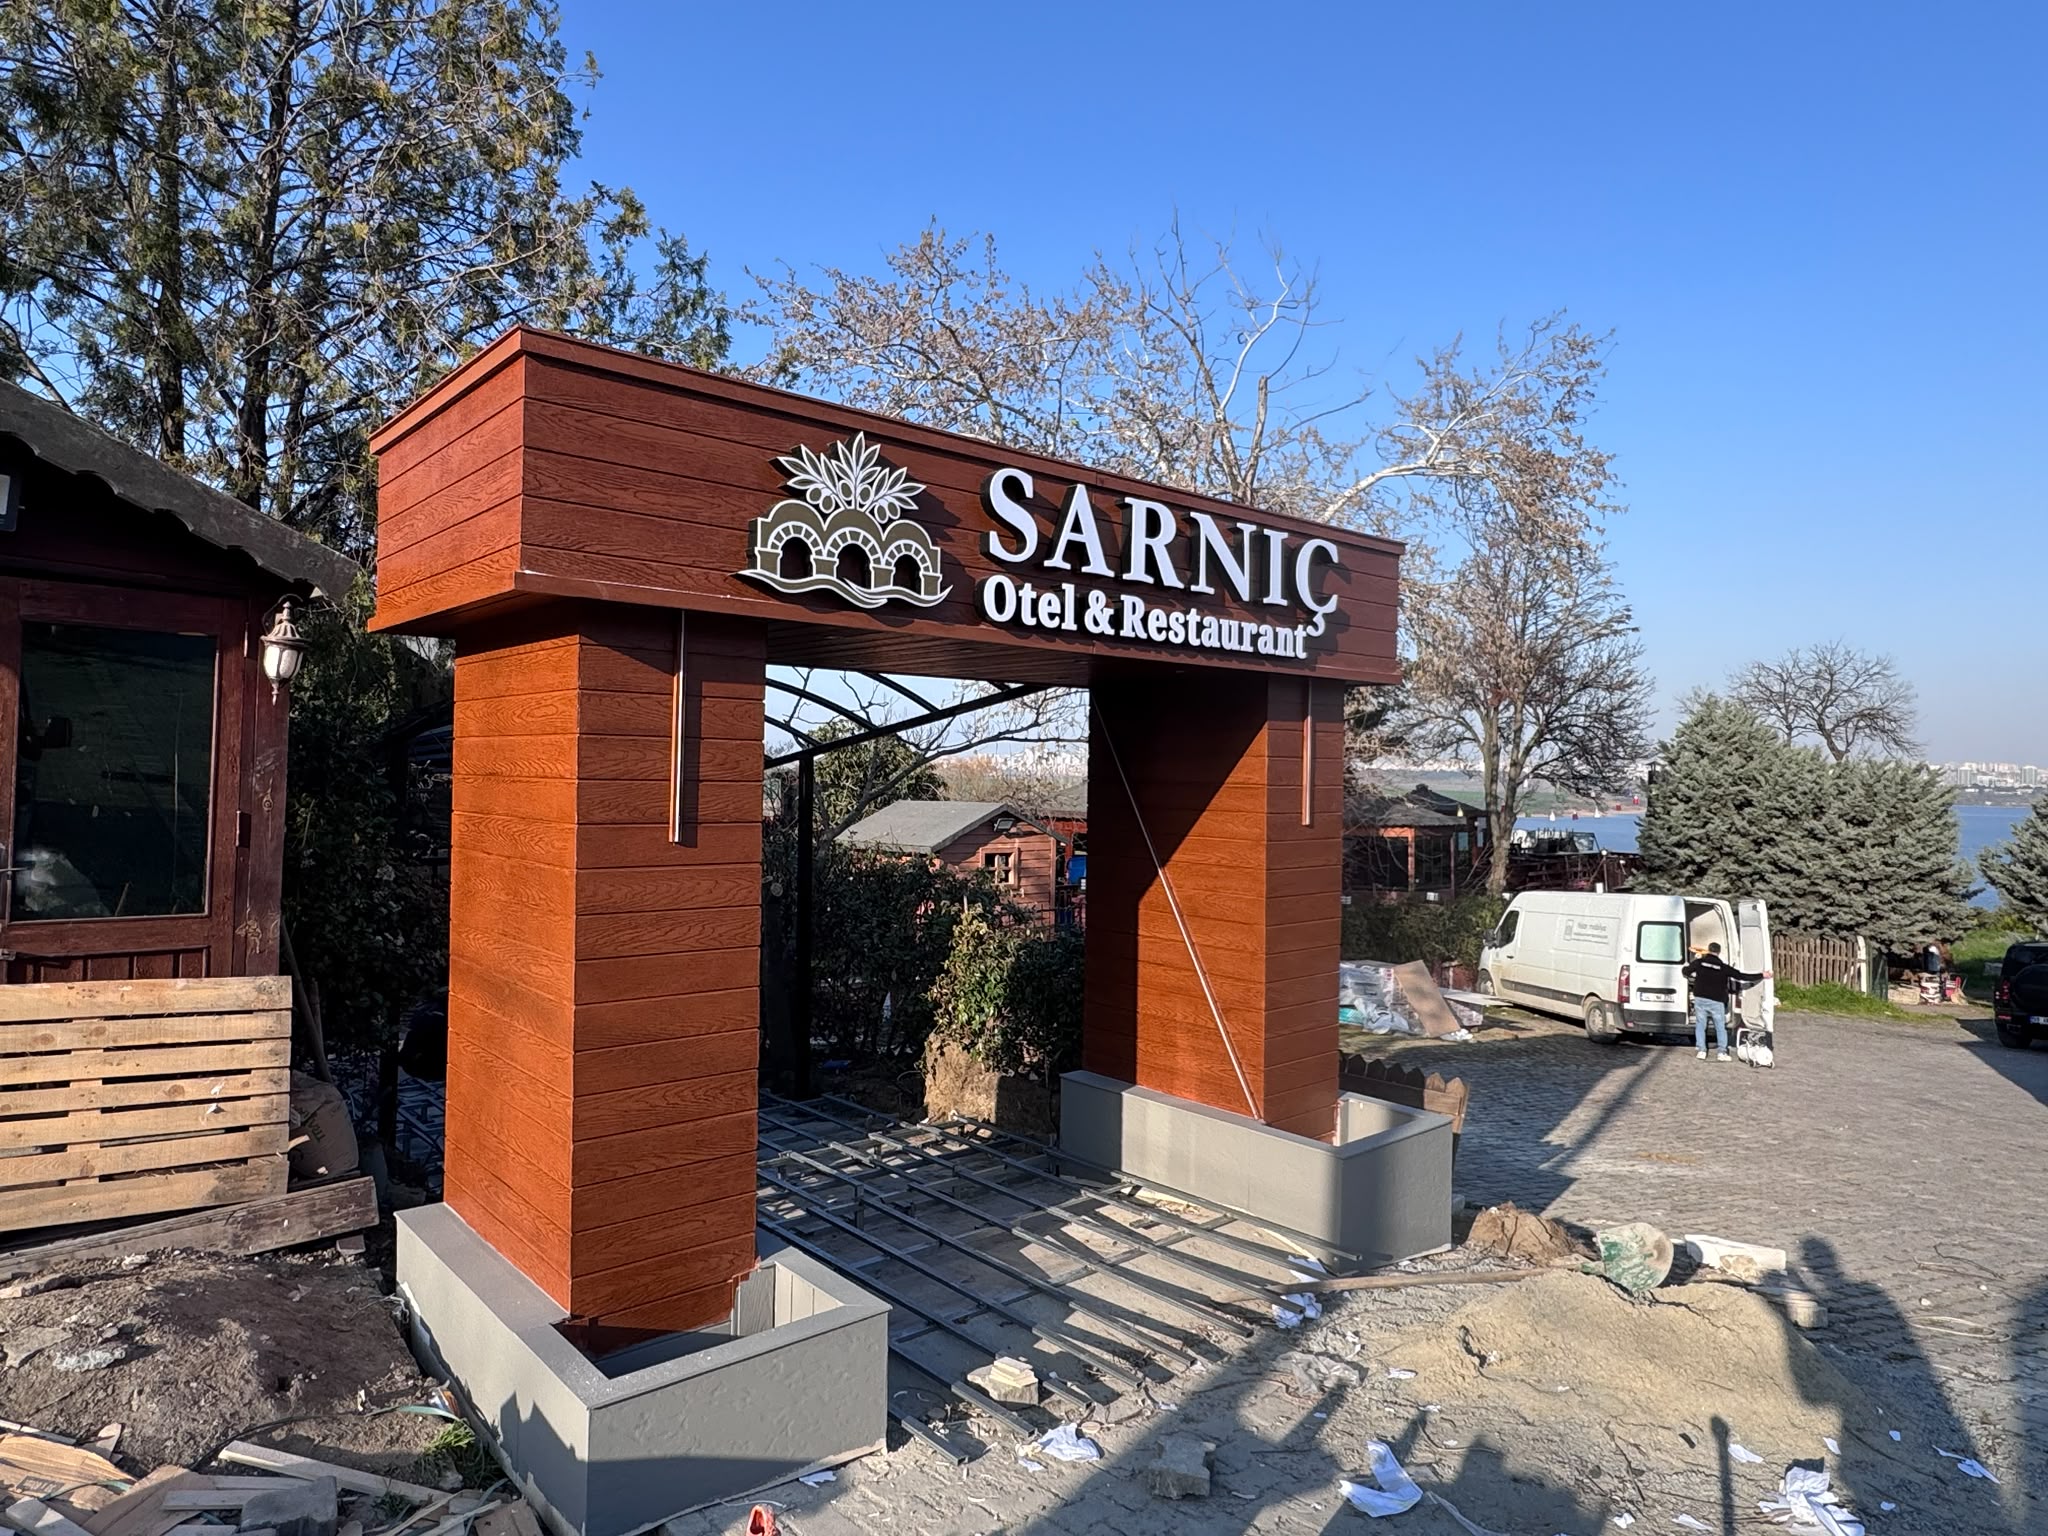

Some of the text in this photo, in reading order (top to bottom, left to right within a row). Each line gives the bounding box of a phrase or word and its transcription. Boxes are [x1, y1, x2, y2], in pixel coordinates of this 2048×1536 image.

[982, 573, 1308, 660] Otel & Restaurant
[988, 467, 1340, 638] SARNIÇ
